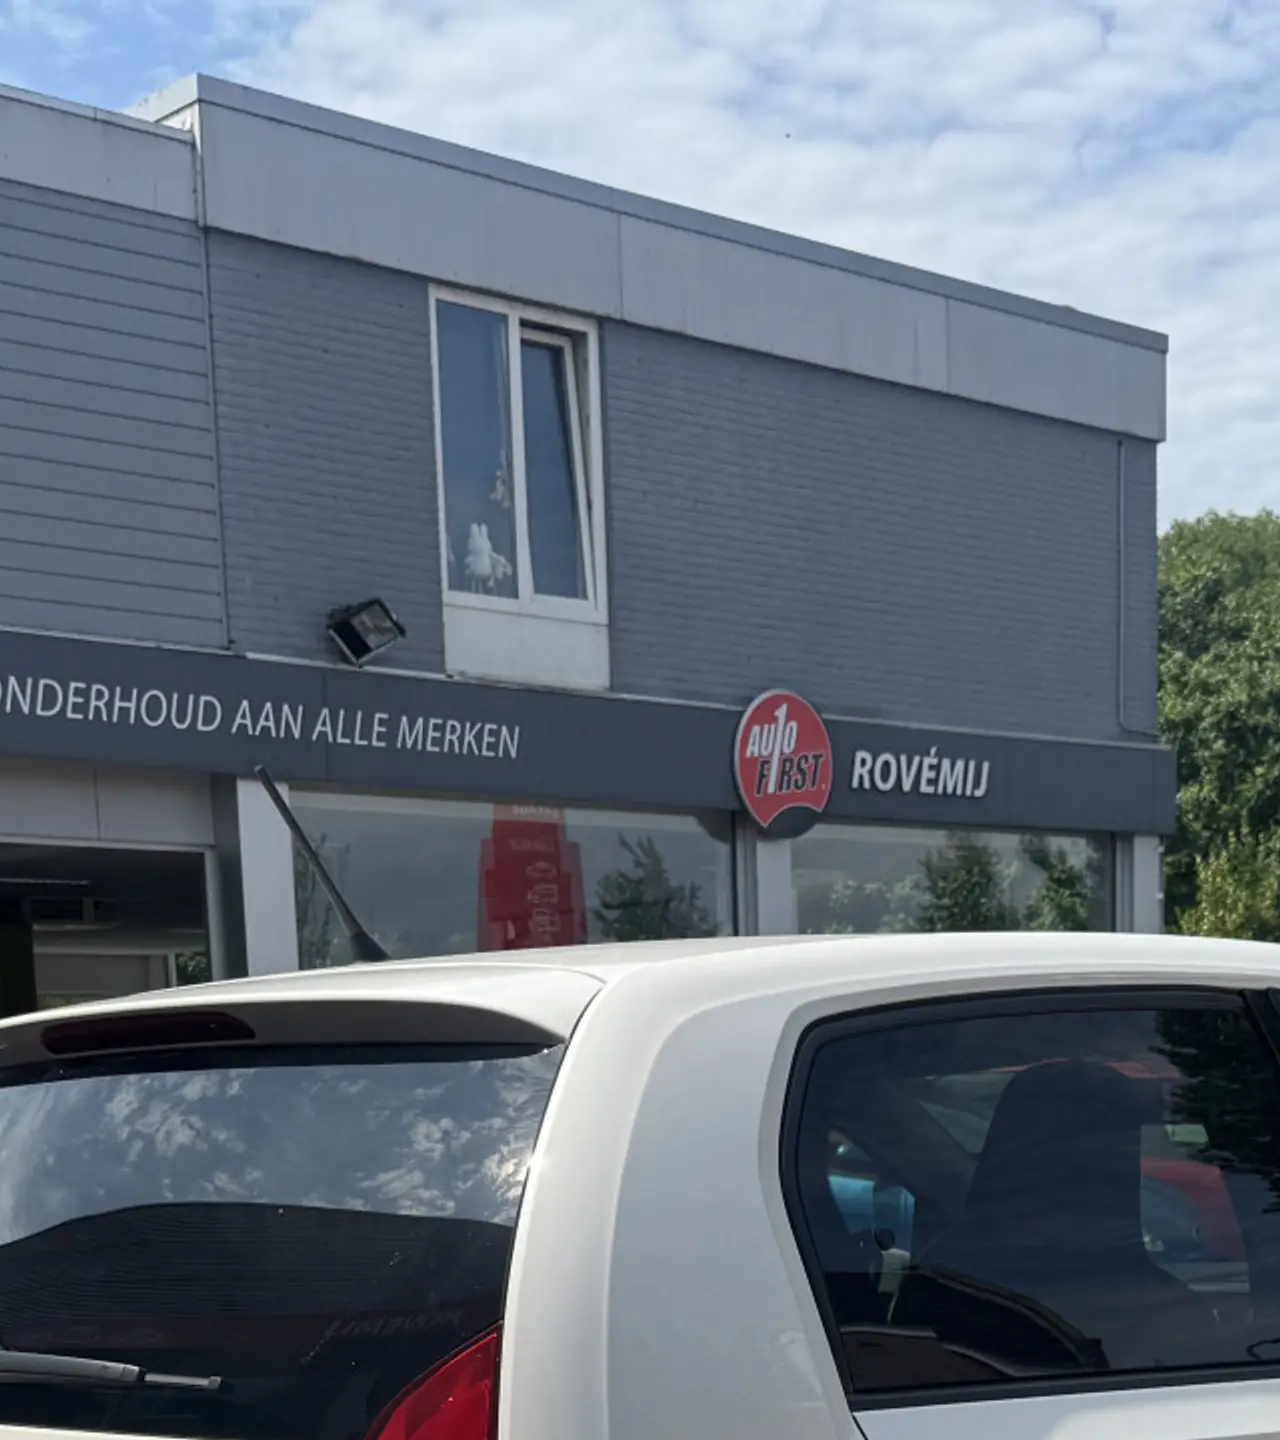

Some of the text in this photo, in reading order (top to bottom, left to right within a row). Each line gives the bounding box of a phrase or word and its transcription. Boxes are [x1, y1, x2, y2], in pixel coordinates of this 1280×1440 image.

[231, 700, 303, 739] AAN
[312, 707, 389, 748] ALLE
[397, 716, 521, 760] MERKEN
[851, 745, 991, 798] ROVÉMIJ
